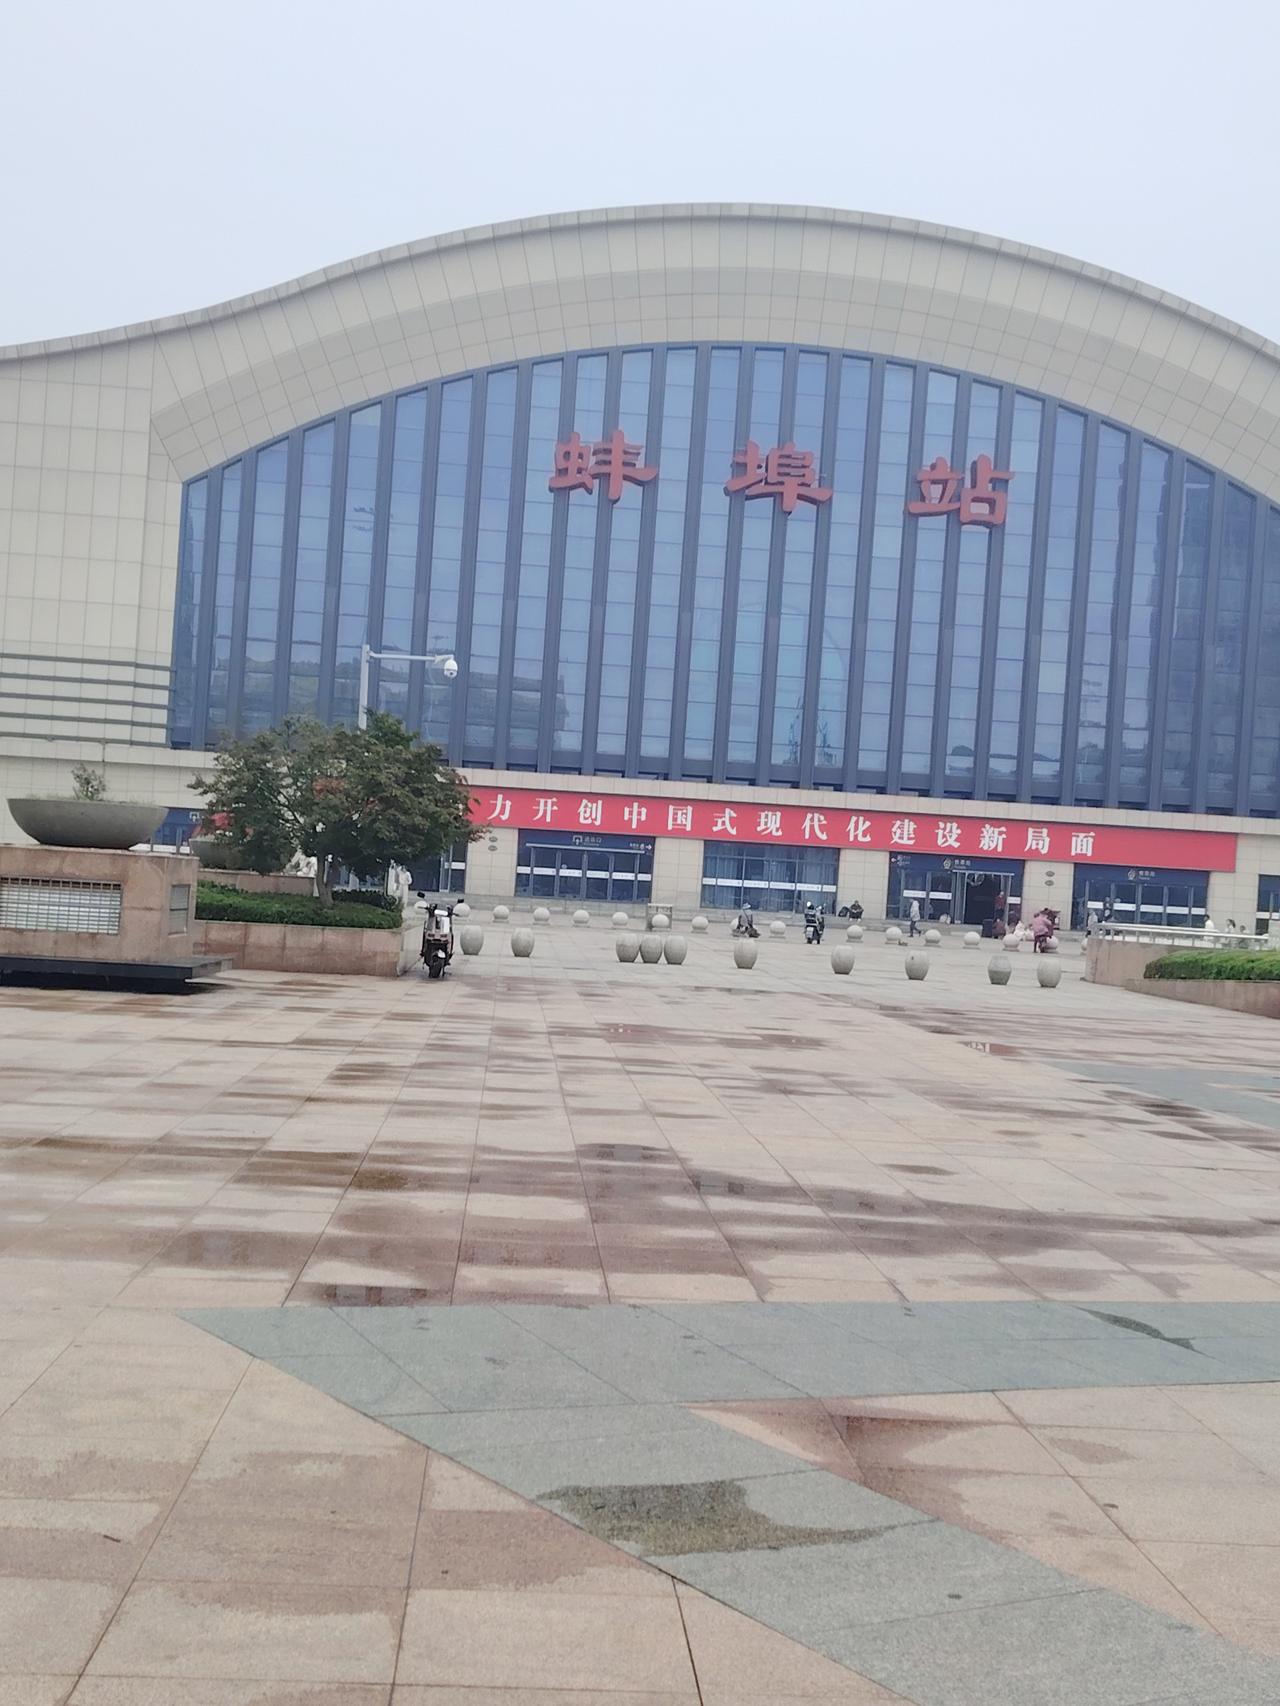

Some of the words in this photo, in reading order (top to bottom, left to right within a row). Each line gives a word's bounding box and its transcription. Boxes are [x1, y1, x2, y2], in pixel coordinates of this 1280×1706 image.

[549, 429, 1011, 528] 蚌埠站
[457, 793, 1096, 858] 力开创中国式现代化建设新局面
